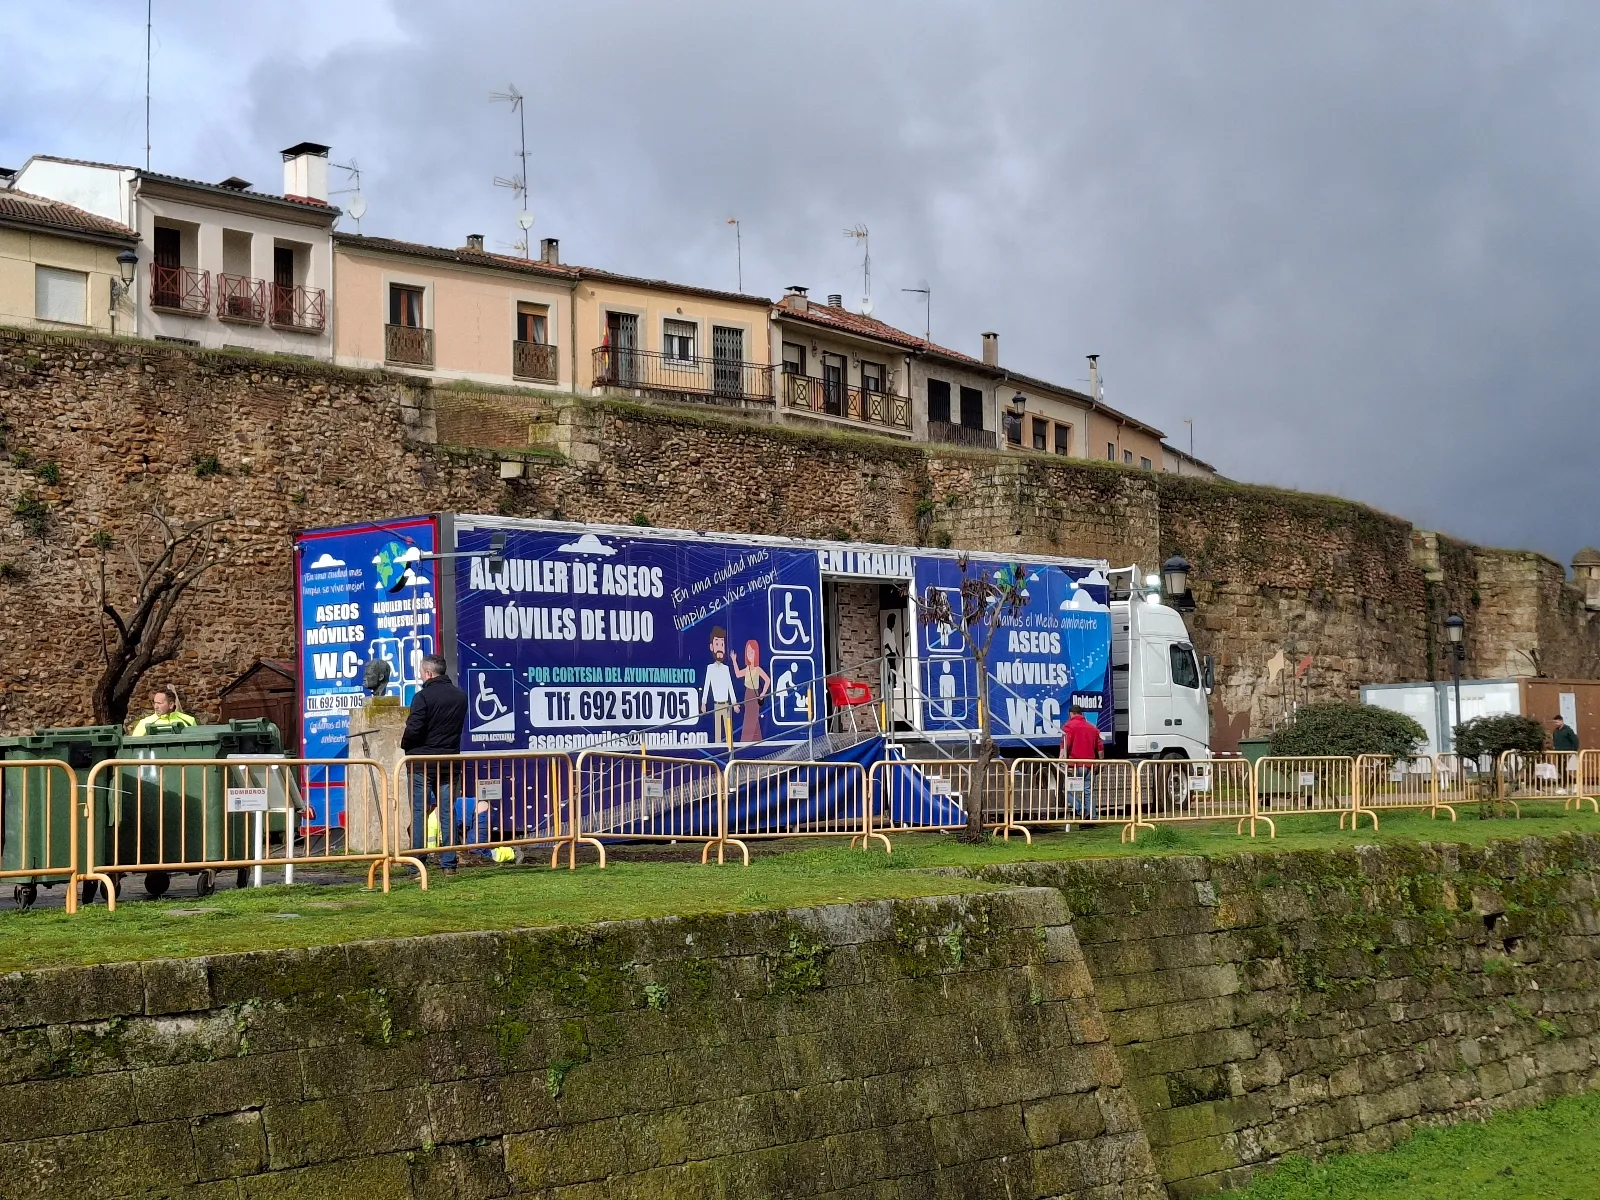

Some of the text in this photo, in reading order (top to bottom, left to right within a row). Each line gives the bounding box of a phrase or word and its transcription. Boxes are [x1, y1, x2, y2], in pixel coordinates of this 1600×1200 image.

[691, 576, 712, 595] una
[713, 554, 746, 584] ciudad
[747, 548, 769, 567] mas
[818, 549, 914, 577] ENTRADA
[470, 556, 664, 598] ALQUILER DE ASEOS
[402, 599, 412, 611] DE
[673, 566, 779, 631] limpia se vive mejor!
[316, 602, 360, 623] ASEOS
[484, 600, 654, 643] MÓVILES DE LUJO
[1025, 612, 1033, 627] el
[306, 624, 365, 647] MÓVILES
[1008, 631, 1061, 655] ASEOS
[528, 667, 696, 684] POR CORTESIA DEL AYUNTAMIENTO
[996, 658, 1068, 687] MÓVILES
[319, 696, 334, 709] 692
[335, 695, 349, 708] 510
[349, 694, 363, 707] 705
[579, 691, 617, 720] 692
[621, 691, 654, 720] 510
[656, 691, 690, 720] 705
[1097, 695, 1103, 709] 2
